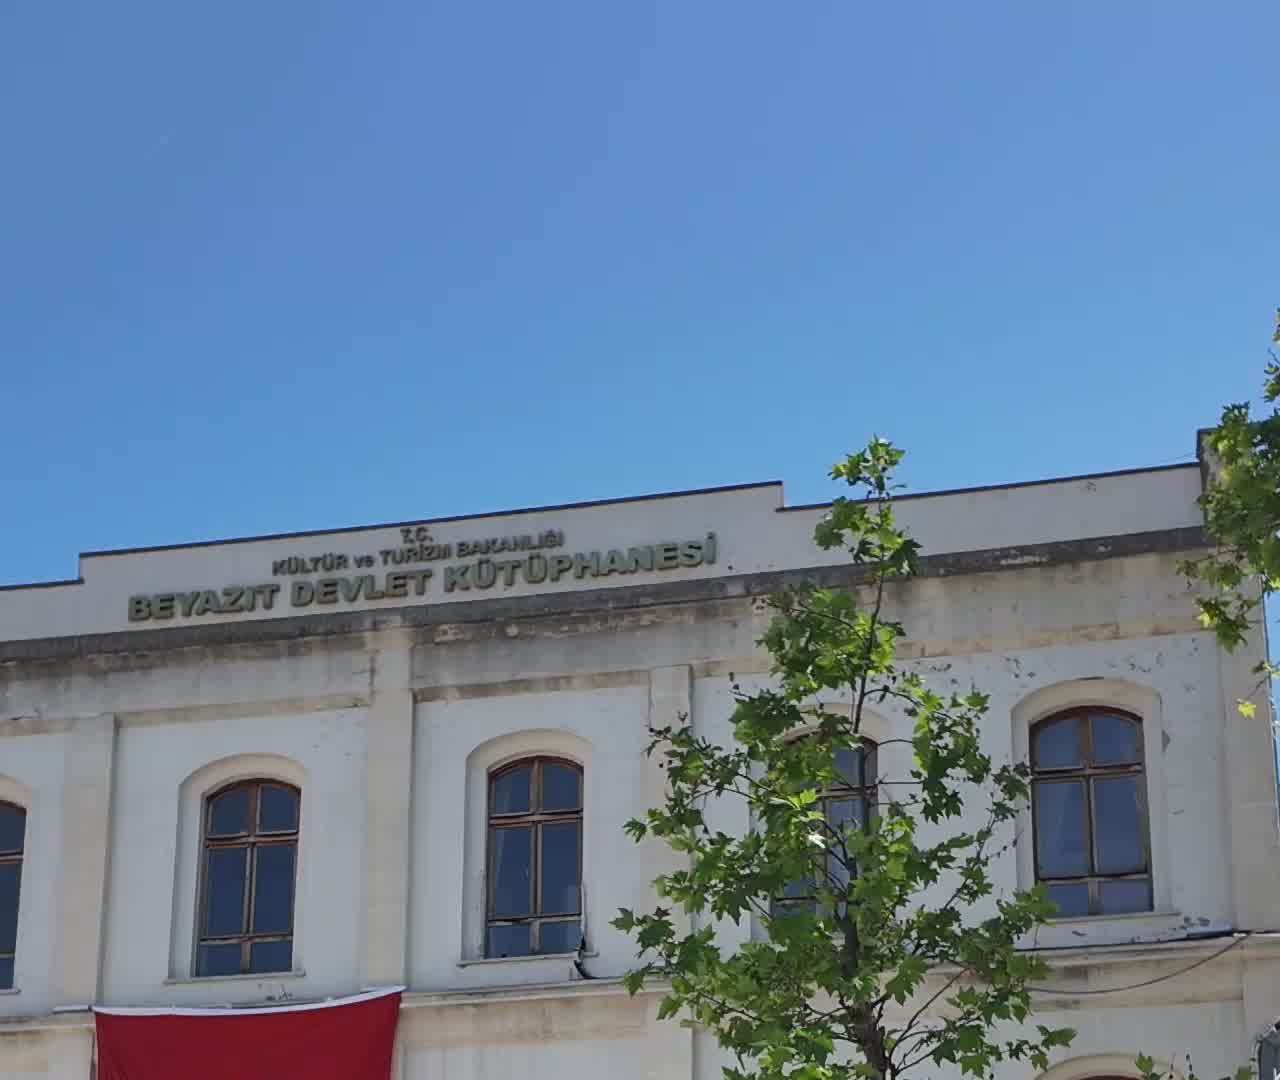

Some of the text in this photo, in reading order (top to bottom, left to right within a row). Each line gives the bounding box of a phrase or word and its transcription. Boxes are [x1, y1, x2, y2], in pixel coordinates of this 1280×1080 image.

[128, 531, 718, 622] BEYAZIT DEVLET KÜTÜPHANESİ
[272, 552, 349, 577] KÜLTÜR
[379, 543, 452, 566] TURİZM
[456, 528, 566, 559] BAKANLIĞI
